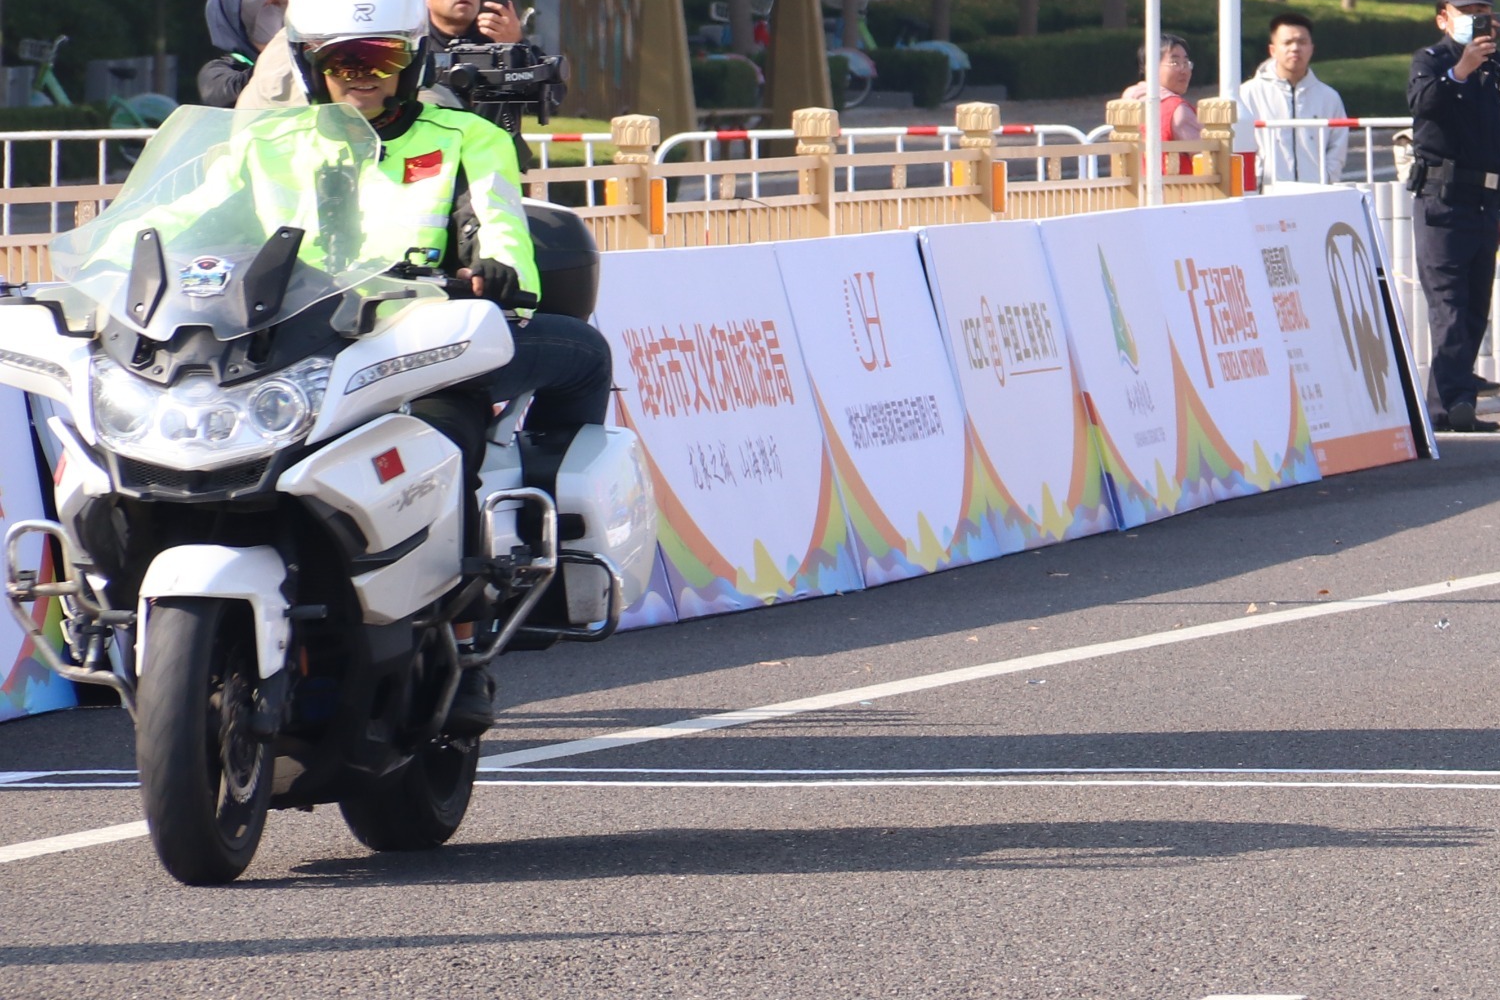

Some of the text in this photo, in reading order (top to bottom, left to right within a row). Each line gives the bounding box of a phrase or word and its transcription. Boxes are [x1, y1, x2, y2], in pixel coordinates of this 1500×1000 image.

[504, 71, 535, 82] RONIN
[622, 317, 795, 421] 潍坊市文化和旅游局
[960, 301, 1058, 371] ICBC 中国工商银行
